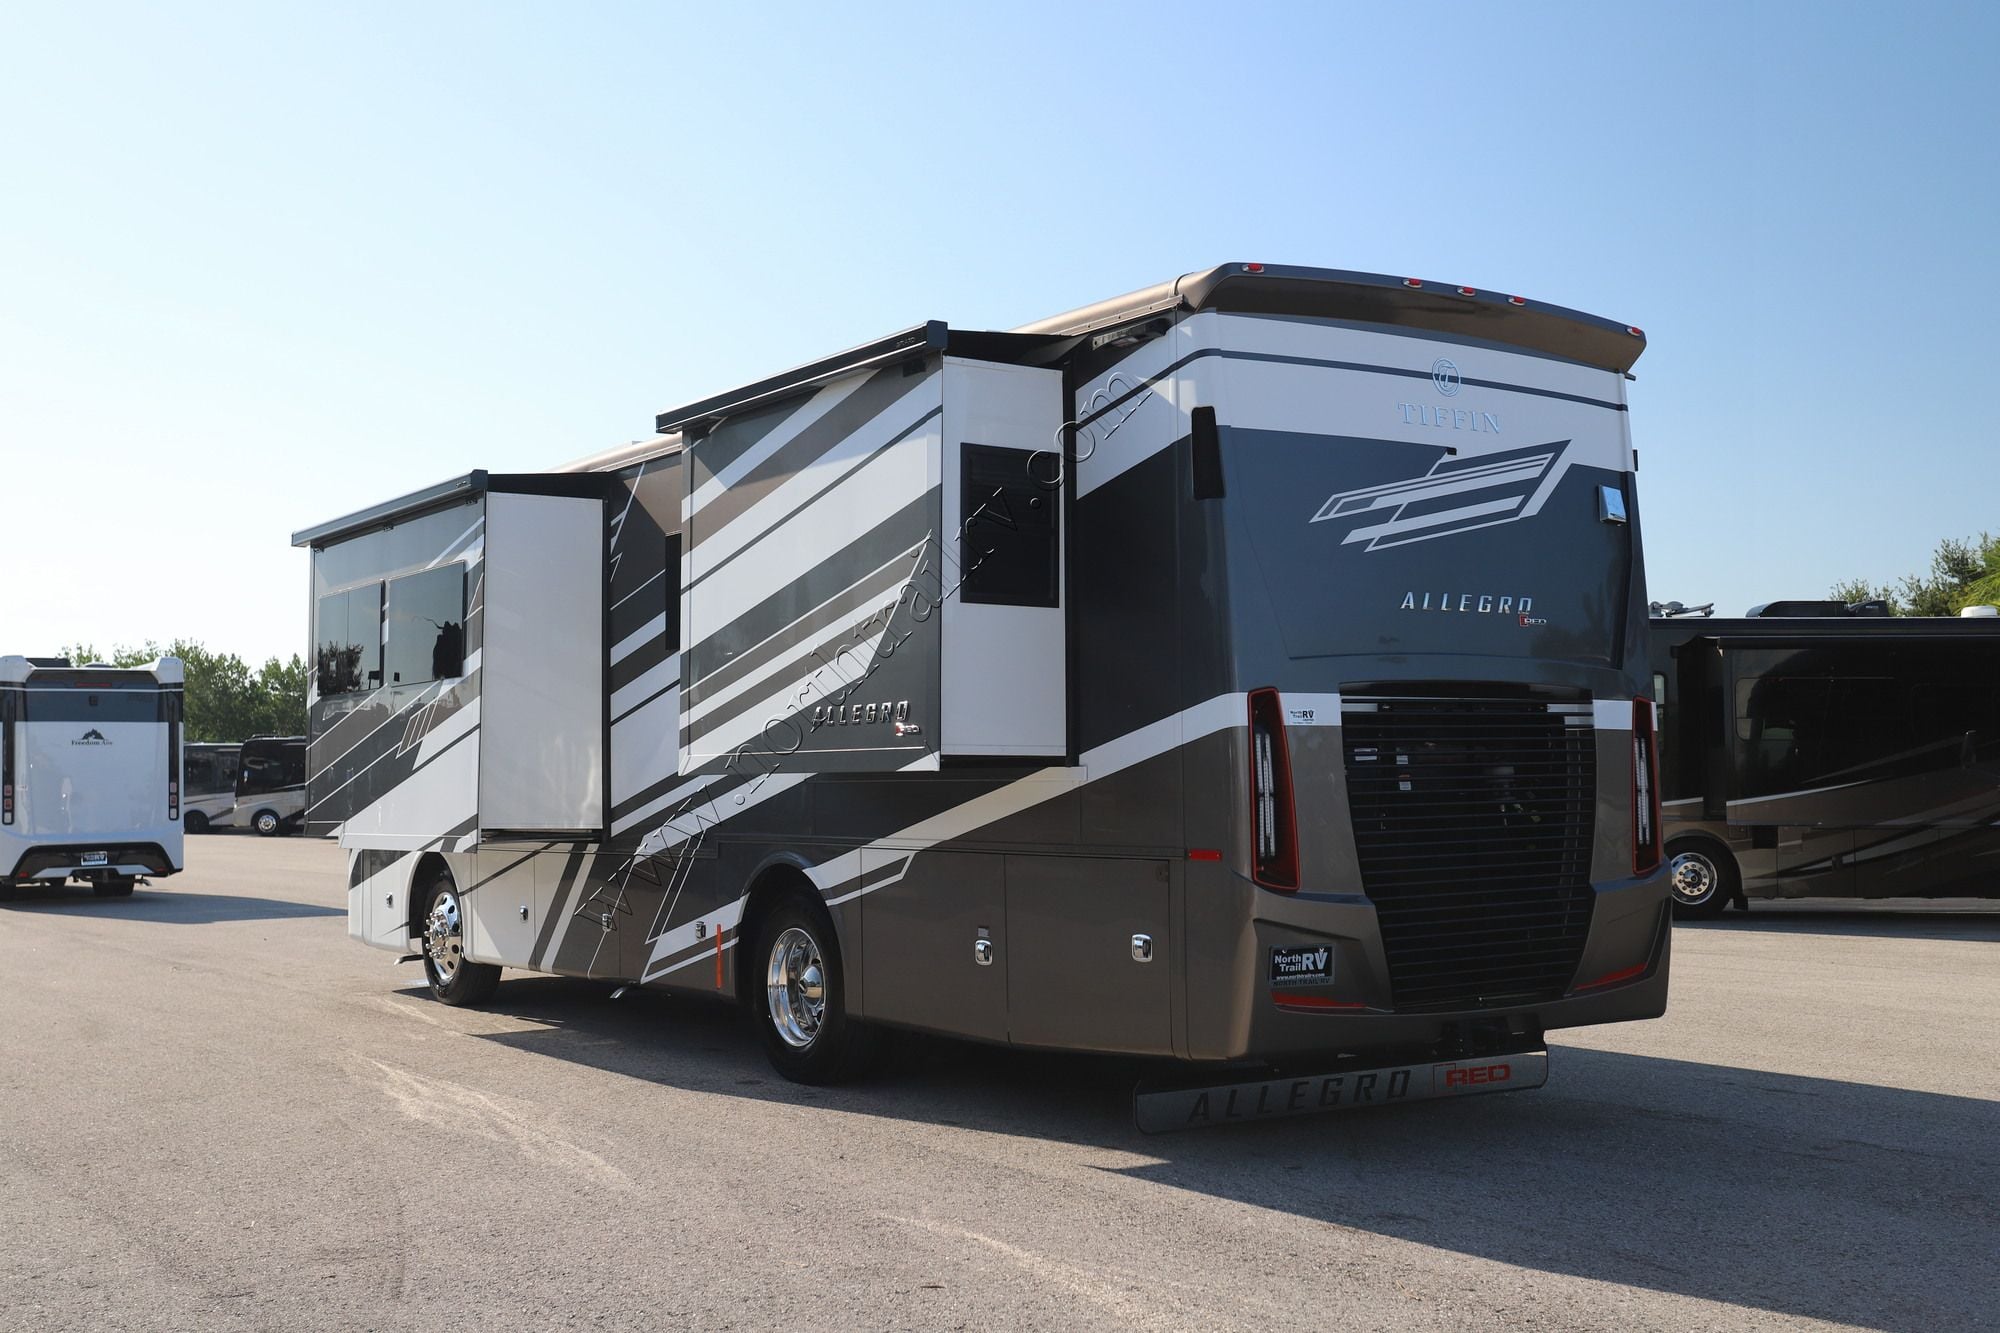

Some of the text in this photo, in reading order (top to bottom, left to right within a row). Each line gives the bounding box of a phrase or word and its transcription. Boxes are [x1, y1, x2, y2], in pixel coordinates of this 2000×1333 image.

[1397, 401, 1500, 434] TIFFIN
[1400, 591, 1532, 615] ALLEGRO
[812, 701, 908, 723] ALLEGRO
[1274, 954, 1301, 964] North
[1280, 963, 1301, 972] Trail
[1302, 951, 1328, 971] RV
[1187, 1063, 1511, 1124] ALLEGRO RED
